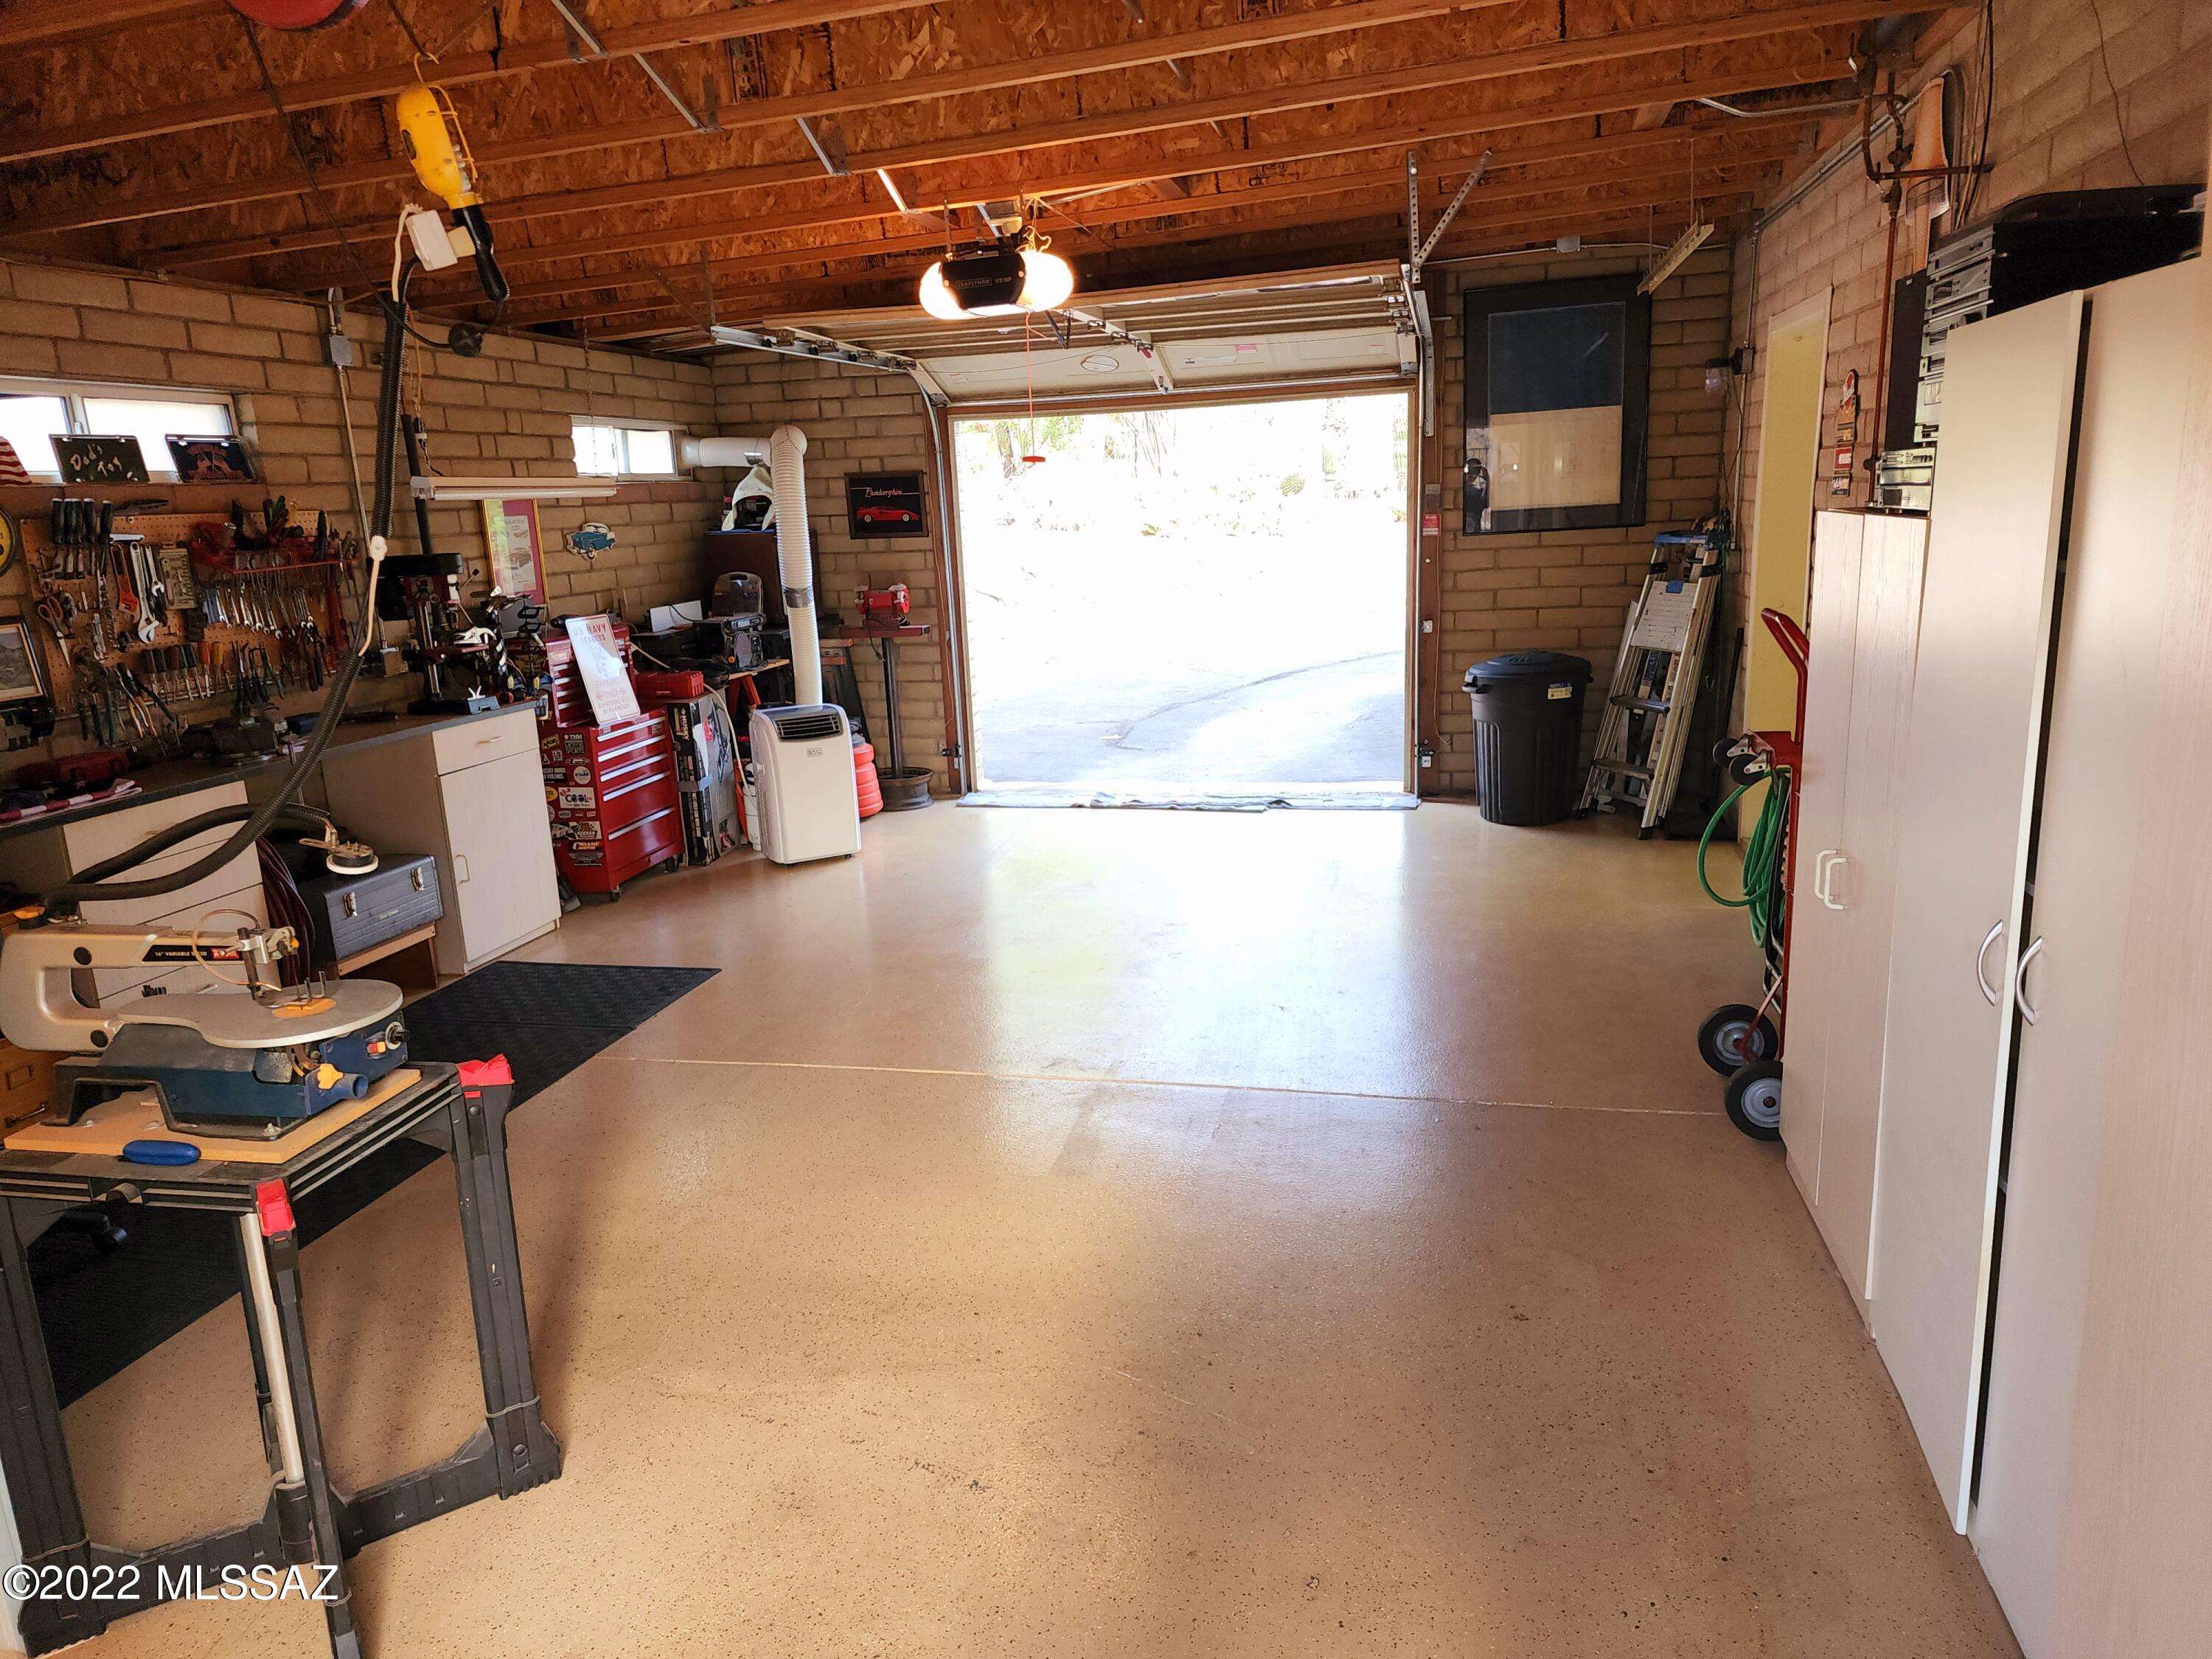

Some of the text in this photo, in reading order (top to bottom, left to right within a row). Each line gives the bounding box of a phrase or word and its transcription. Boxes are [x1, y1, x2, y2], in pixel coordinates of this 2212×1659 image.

[865, 487, 902, 498] Lamborghini
[572, 623, 606, 636] US NAVY
[580, 633, 607, 644] SEABEES
[681, 715, 689, 740] HUSKY
[565, 794, 590, 803] COOL
